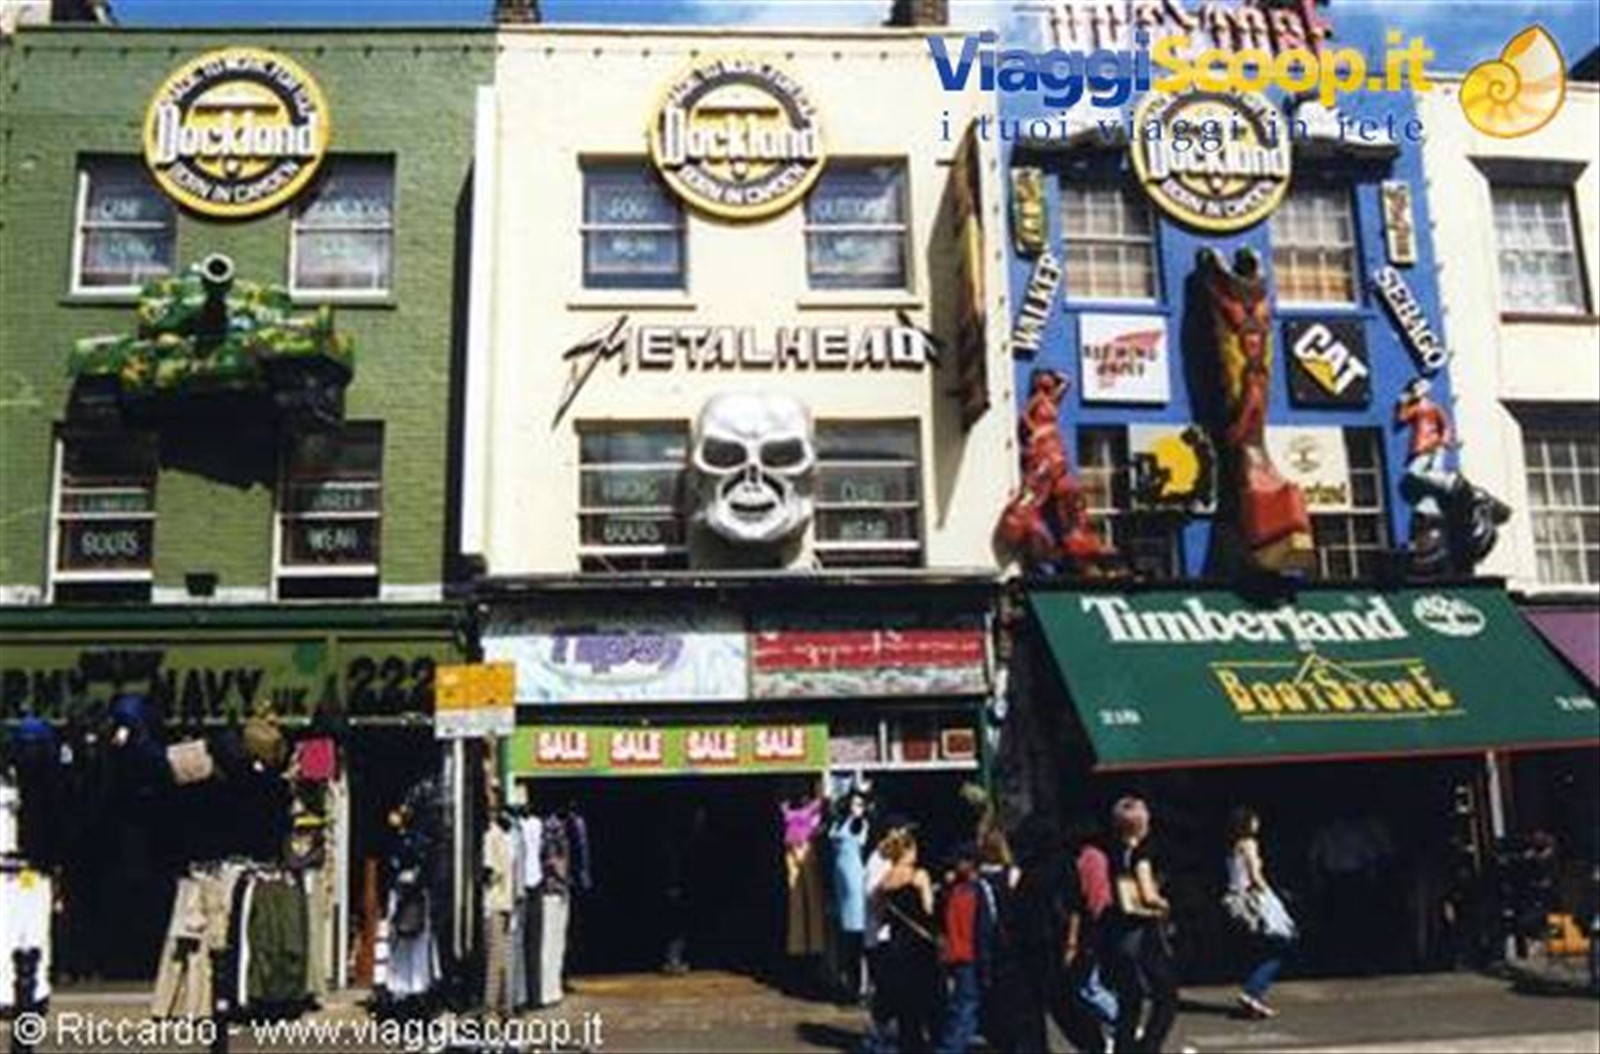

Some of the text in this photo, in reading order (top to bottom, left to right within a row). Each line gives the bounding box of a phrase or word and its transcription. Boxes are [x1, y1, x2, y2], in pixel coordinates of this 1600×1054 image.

[1374, 264, 1447, 369] SEBAGO
[552, 313, 944, 428] METALHEAD
[1294, 323, 1368, 395] CAT
[1079, 594, 1409, 642] Timberland
[536, 729, 588, 761] SALE
[611, 730, 662, 761] SALE
[687, 729, 736, 761] SALE
[756, 726, 804, 757] SALE
